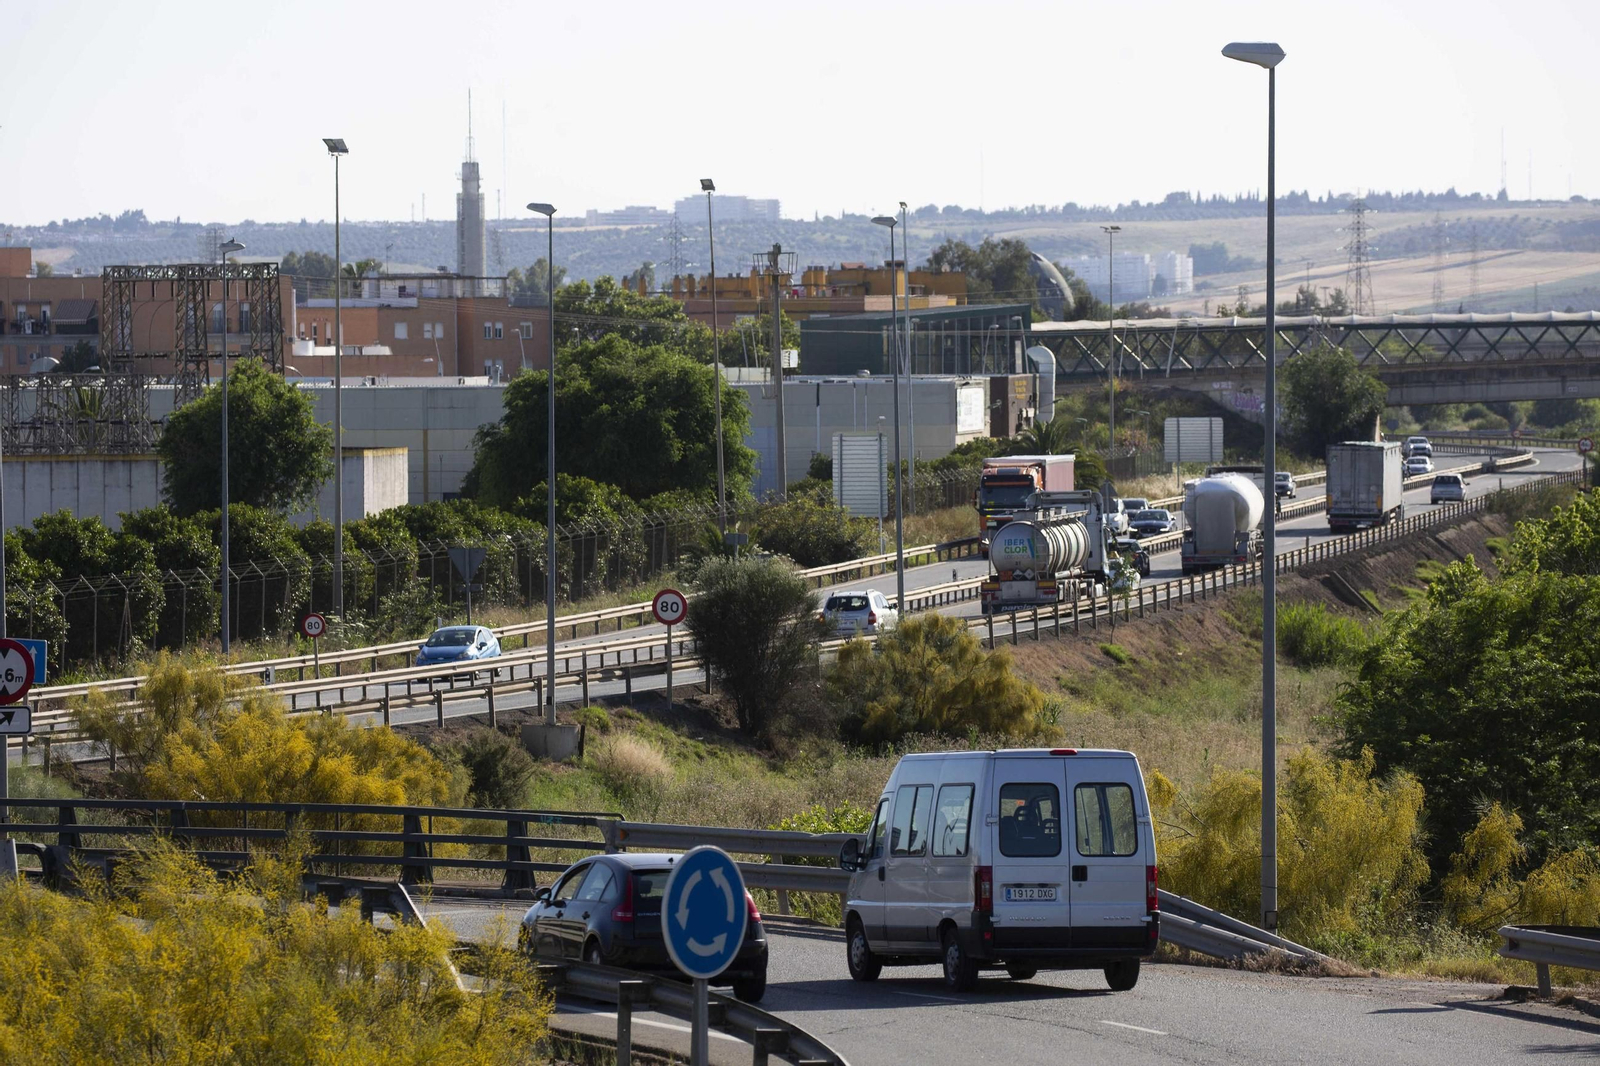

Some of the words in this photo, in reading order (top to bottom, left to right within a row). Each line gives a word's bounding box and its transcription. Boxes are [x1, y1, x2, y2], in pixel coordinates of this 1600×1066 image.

[1004, 538, 1025, 546] IBER
[1004, 546, 1027, 554] CLOR
[660, 600, 680, 613] 80
[307, 621, 320, 630] 80
[0, 668, 24, 683] .6m
[1013, 889, 1035, 899] 1912
[1037, 889, 1053, 899] DXG
